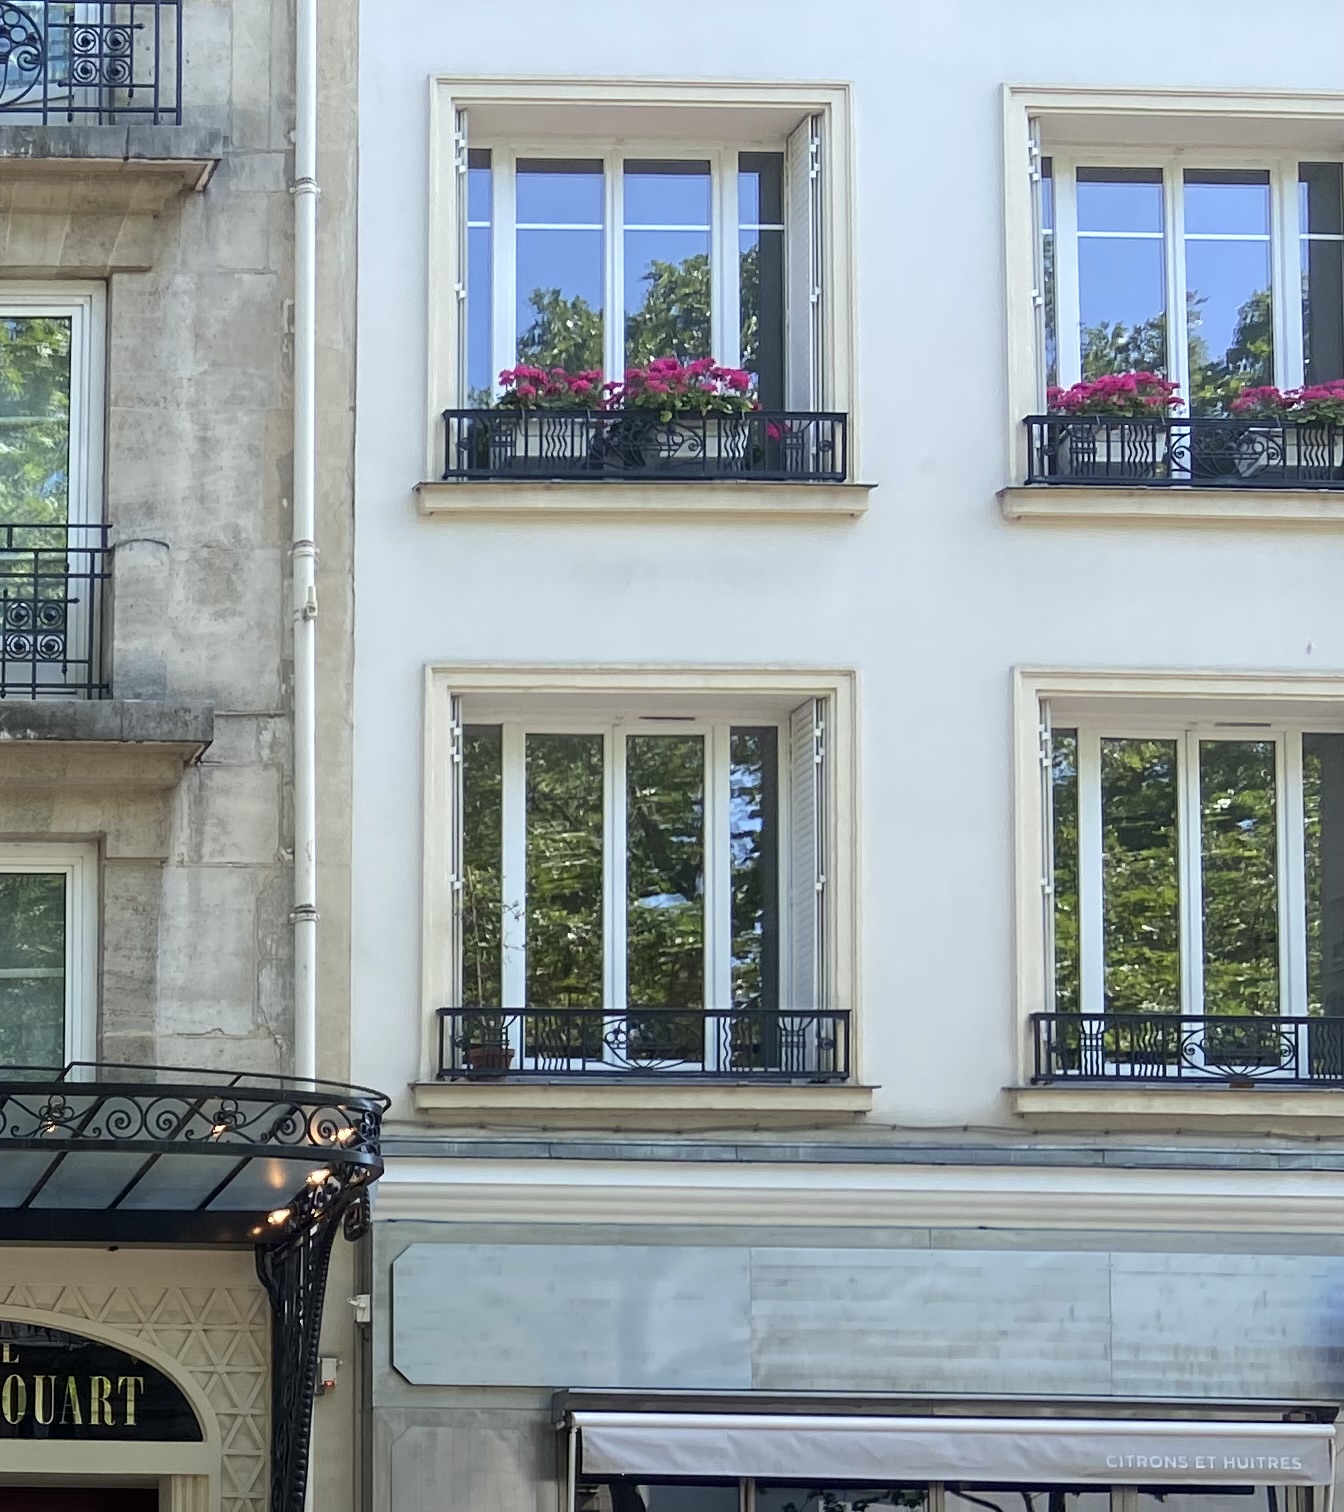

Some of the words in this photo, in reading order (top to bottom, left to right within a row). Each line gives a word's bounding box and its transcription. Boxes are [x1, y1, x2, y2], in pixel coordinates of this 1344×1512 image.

[1105, 1454, 1189, 1469] CITRONS
[1194, 1455, 1217, 1470] ET
[1223, 1455, 1303, 1471] HUITRES
